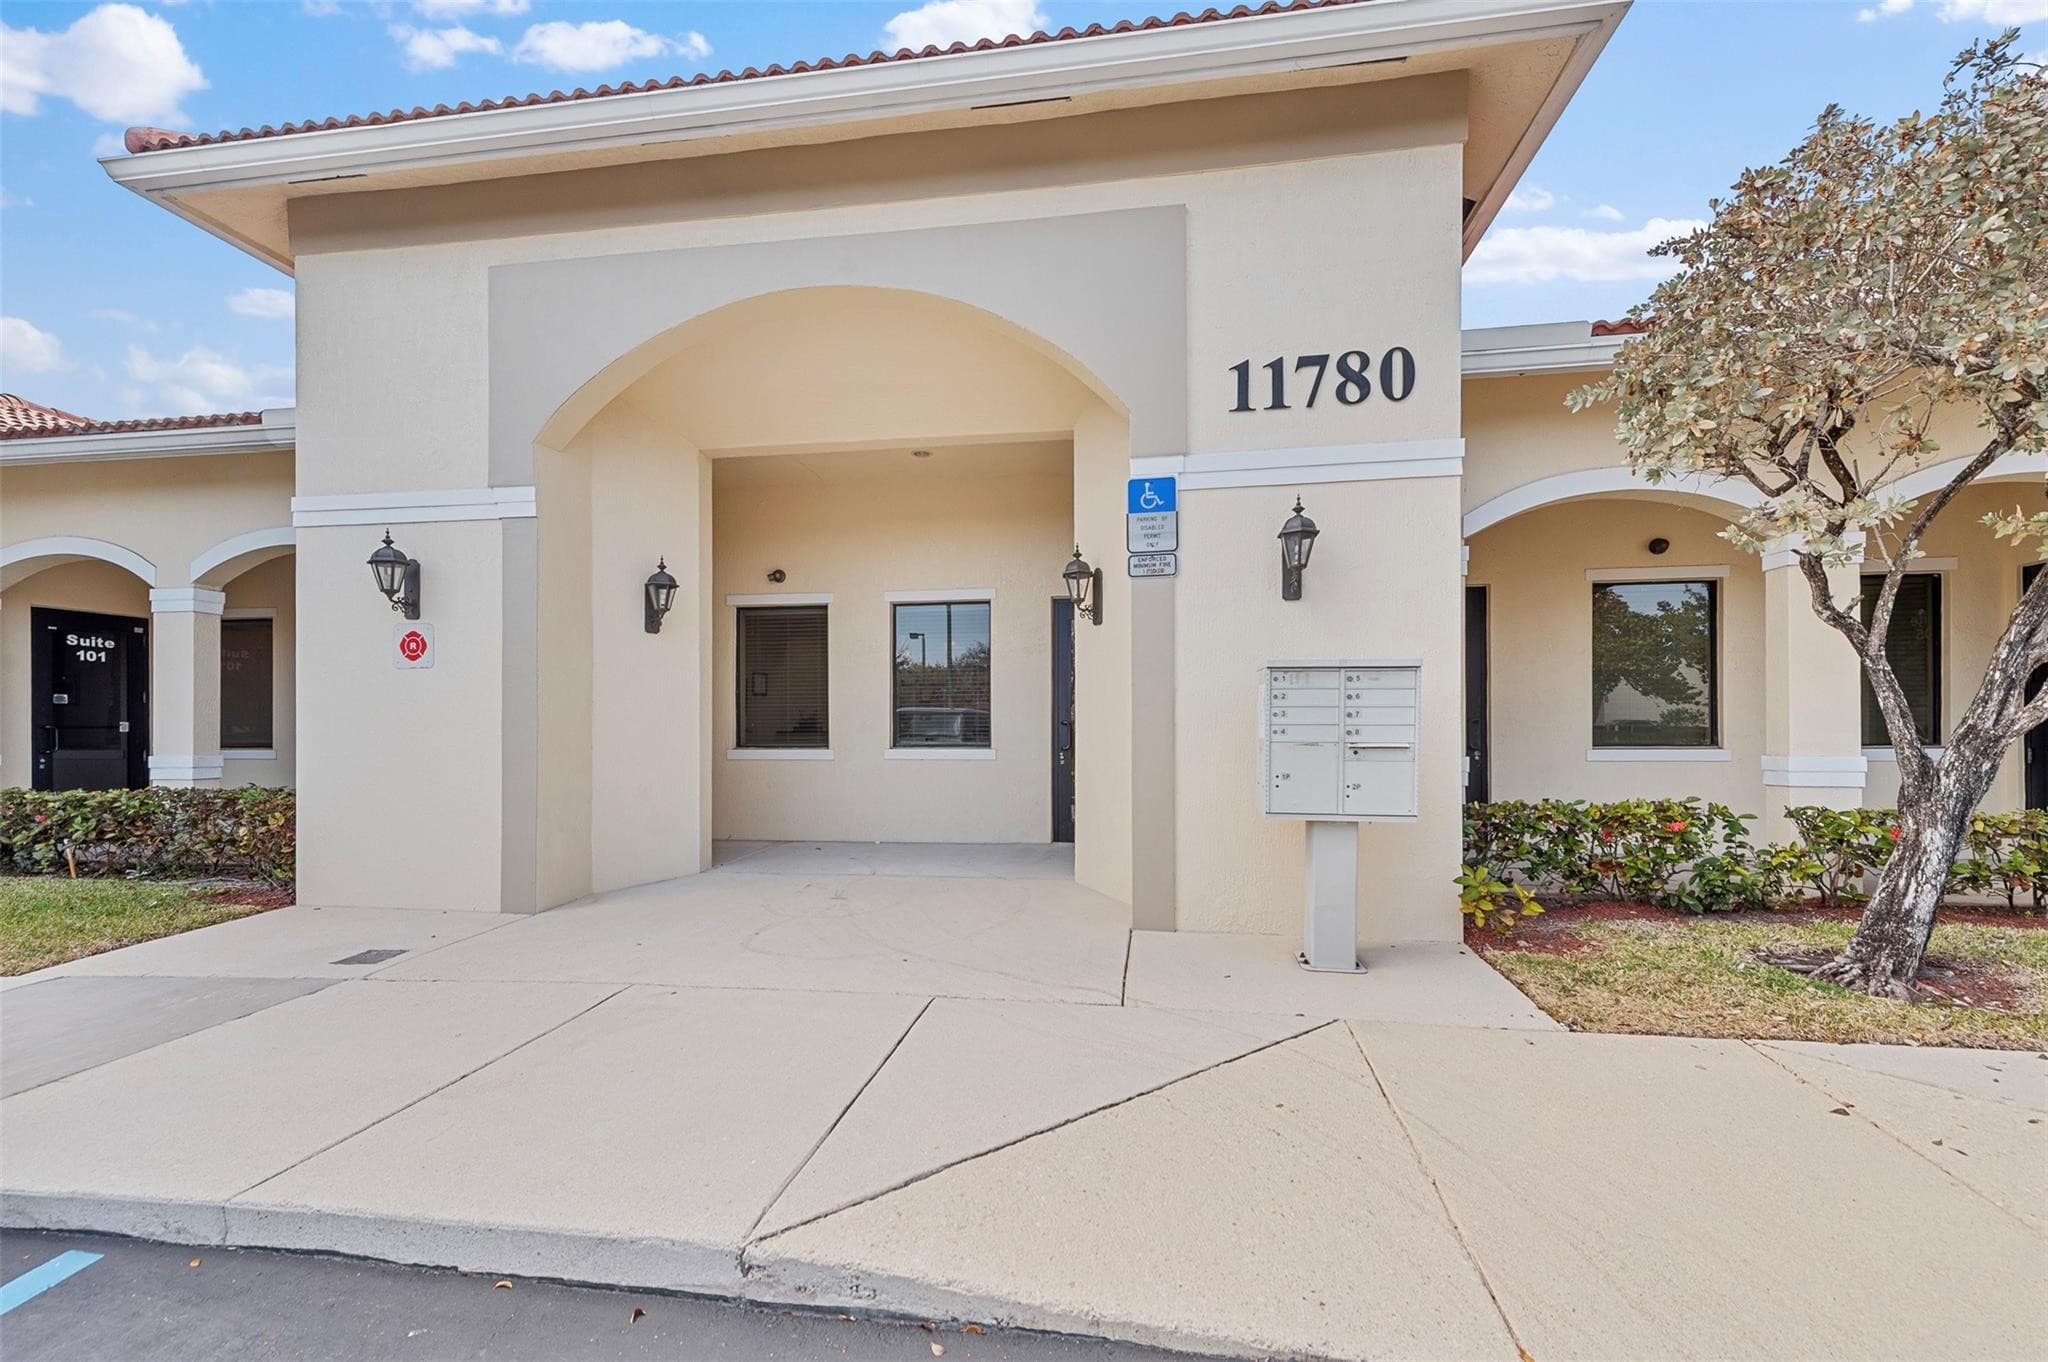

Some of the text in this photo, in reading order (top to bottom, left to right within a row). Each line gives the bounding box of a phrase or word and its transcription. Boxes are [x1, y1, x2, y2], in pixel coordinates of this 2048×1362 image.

[1228, 346, 1416, 413] 11780
[66, 634, 116, 649] Suite
[409, 641, 417, 650] R
[76, 650, 106, 663] 101
